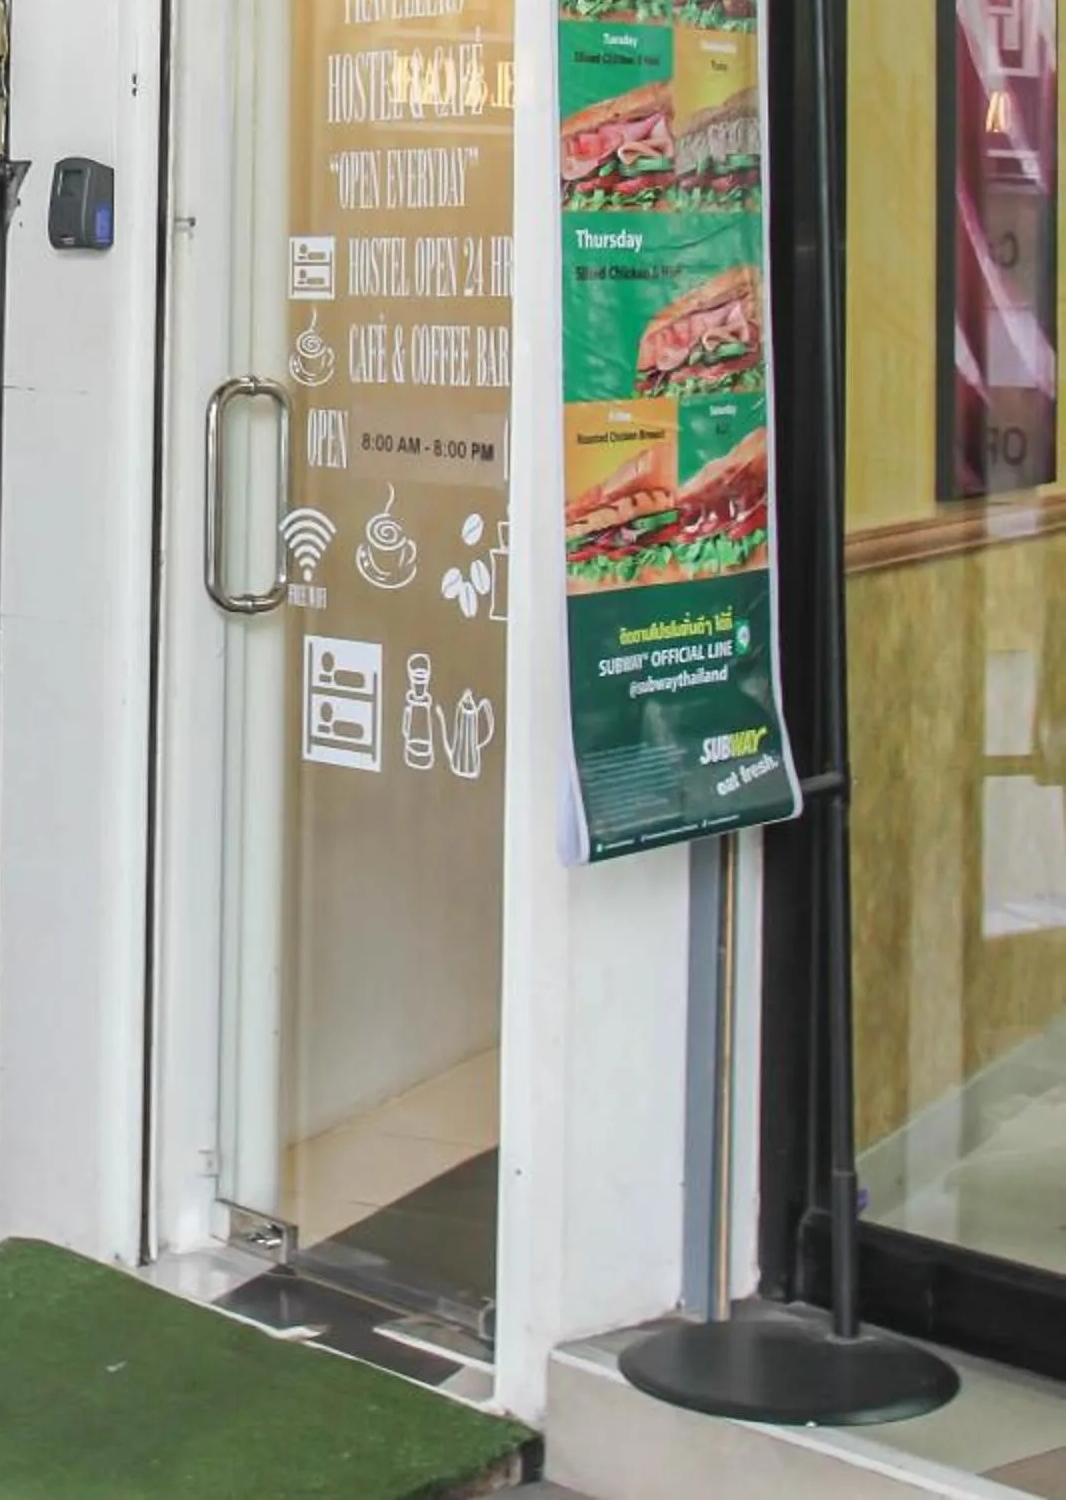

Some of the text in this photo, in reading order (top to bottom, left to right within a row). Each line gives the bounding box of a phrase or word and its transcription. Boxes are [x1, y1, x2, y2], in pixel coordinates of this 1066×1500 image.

[327, 49, 403, 125] HOSTEL
[348, 236, 410, 297] HOSTEL
[415, 236, 458, 297] OPEN
[464, 236, 483, 297] 24
[575, 229, 643, 252] Thursday
[392, 323, 405, 384] &
[411, 324, 471, 387] COFFEE
[476, 326, 512, 388] BAR
[307, 408, 348, 469] OPEN
[361, 432, 393, 453] 8:00
[397, 436, 421, 456] AM
[471, 442, 495, 462] PM
[651, 644, 705, 668] OFFICIAL
[708, 639, 734, 660] LINE
[715, 768, 741, 796] eat
